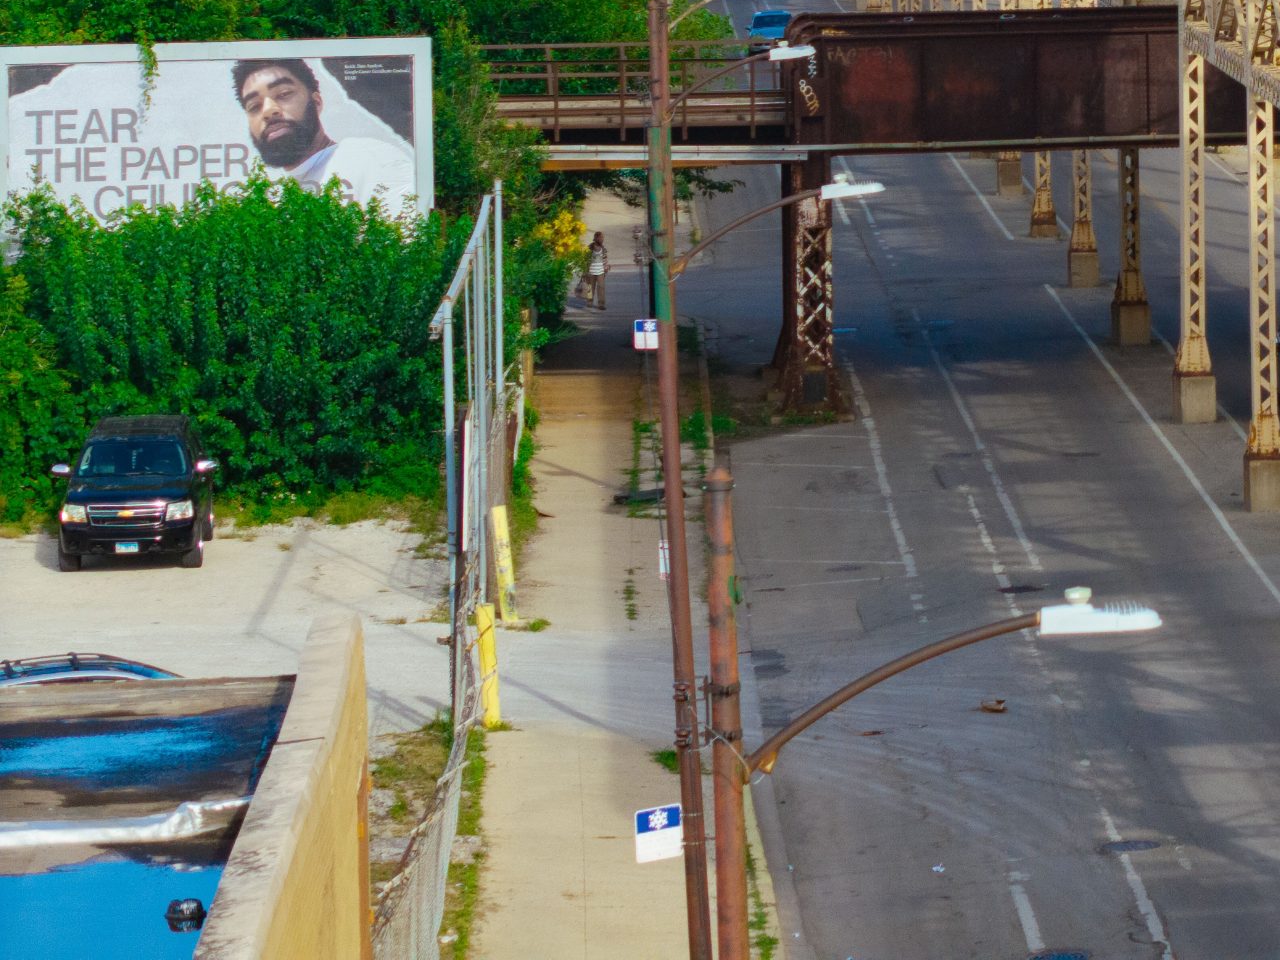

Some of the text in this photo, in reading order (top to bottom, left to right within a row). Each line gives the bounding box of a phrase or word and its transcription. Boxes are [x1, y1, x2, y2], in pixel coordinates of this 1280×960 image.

[25, 107, 138, 145] TEAR
[25, 143, 250, 183] THE PAPER
